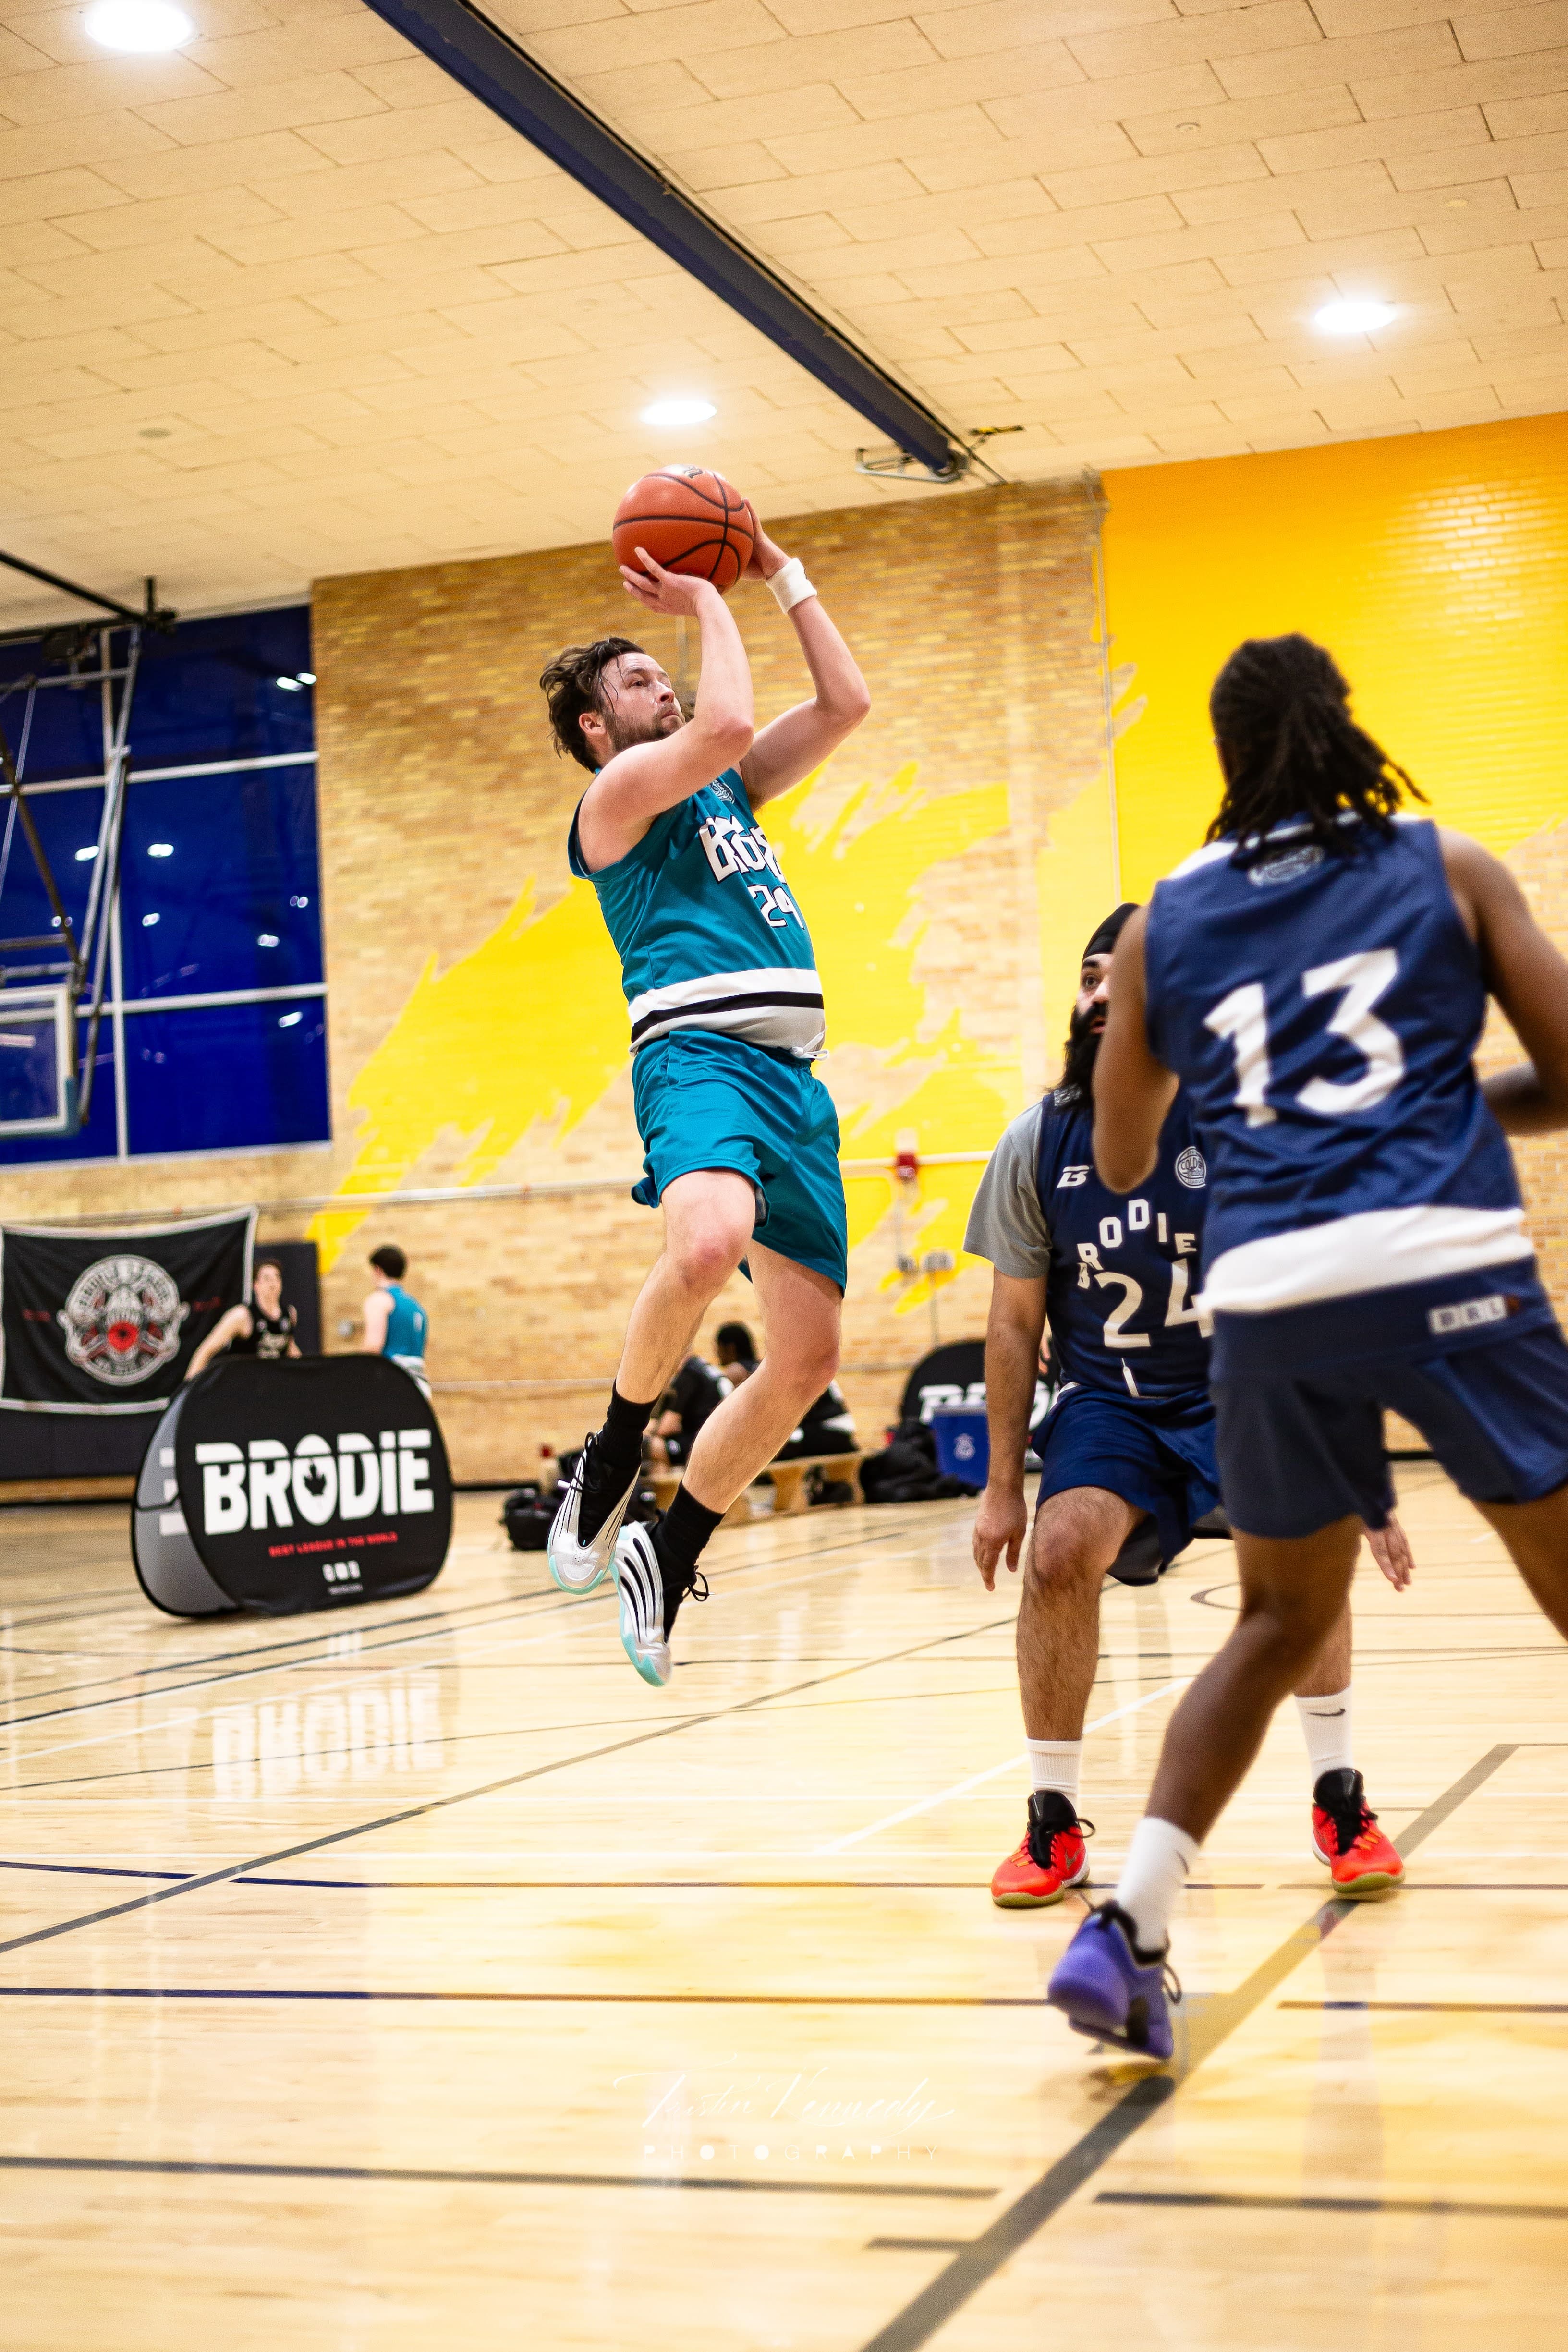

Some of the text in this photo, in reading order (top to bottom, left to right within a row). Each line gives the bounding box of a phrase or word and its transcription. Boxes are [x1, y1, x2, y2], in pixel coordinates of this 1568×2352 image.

[1203, 947, 1406, 1128] 13
[1094, 1257, 1215, 1349] 24
[195, 1428, 435, 1536] BRODIE
